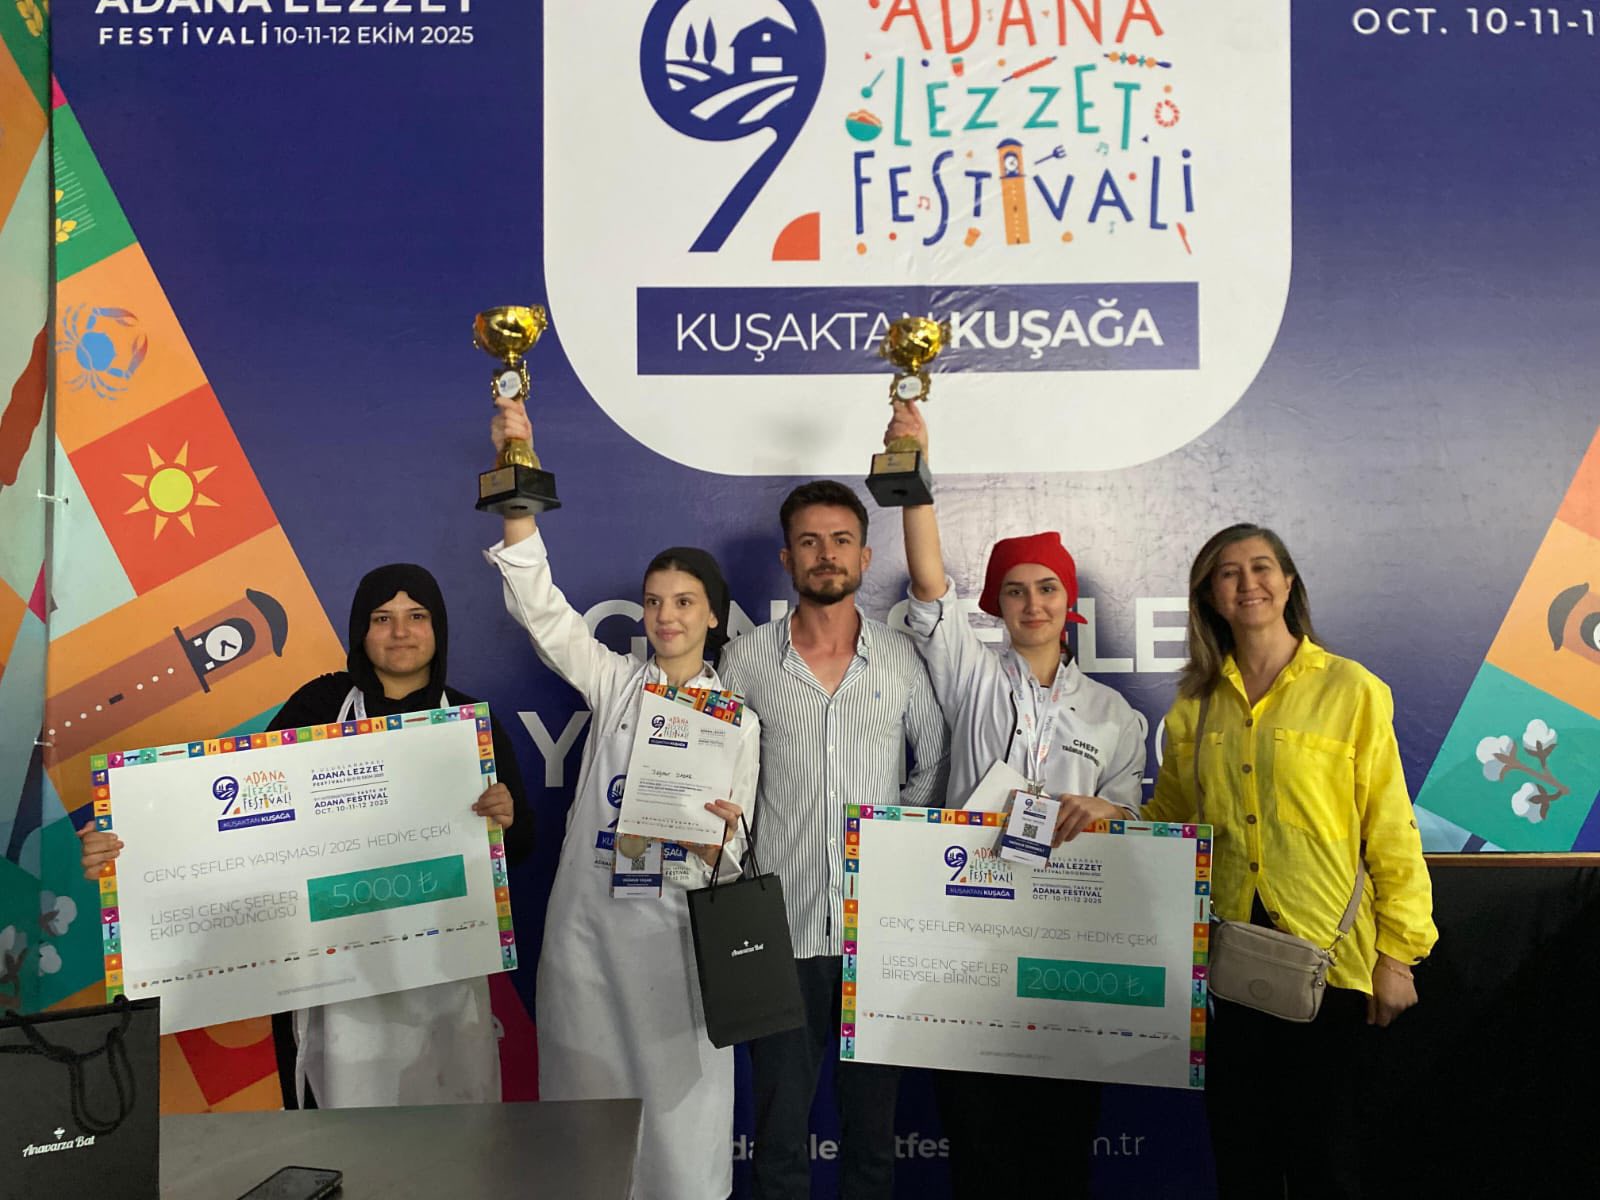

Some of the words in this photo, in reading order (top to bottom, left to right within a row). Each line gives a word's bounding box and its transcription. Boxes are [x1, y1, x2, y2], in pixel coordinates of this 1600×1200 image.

[99, 21, 267, 45] FESTİVALİ
[274, 26, 351, 44] 10-11-12
[357, 22, 414, 44] EKİM
[421, 26, 475, 44] 2025
[1352, 7, 1447, 35] OCT.
[1465, 8, 1600, 35] 10-11-1
[893, 56, 1142, 150] LEZZET
[676, 312, 934, 362] KUŞAKTA
[950, 298, 1164, 359] KUŞAĞA
[245, 771, 286, 785] ADANA
[312, 771, 346, 781] ADANA
[347, 765, 384, 776] LEZZET
[314, 799, 345, 808] ADANA
[347, 792, 389, 803] FESTIVAL
[337, 802, 367, 812] 10-11-12
[370, 799, 389, 807] 2025
[143, 865, 187, 883] GENÇ
[191, 856, 245, 878] ŞEFLER
[329, 838, 361, 854] 2025
[1066, 863, 1103, 871] LEZZET
[333, 873, 411, 909] 5.000
[1063, 889, 1102, 897] FESTIVAL
[198, 899, 240, 917] GENÇ
[244, 890, 299, 911] ŞEFLER
[879, 916, 915, 932] GENÇ
[918, 919, 965, 933] ŞEFLER
[1041, 928, 1071, 940] 2025
[961, 960, 1009, 974] ŞEFLER
[1027, 967, 1118, 996] 20.000
[22, 1144, 74, 1157] Anavarza
[75, 1135, 95, 1147] Bal
